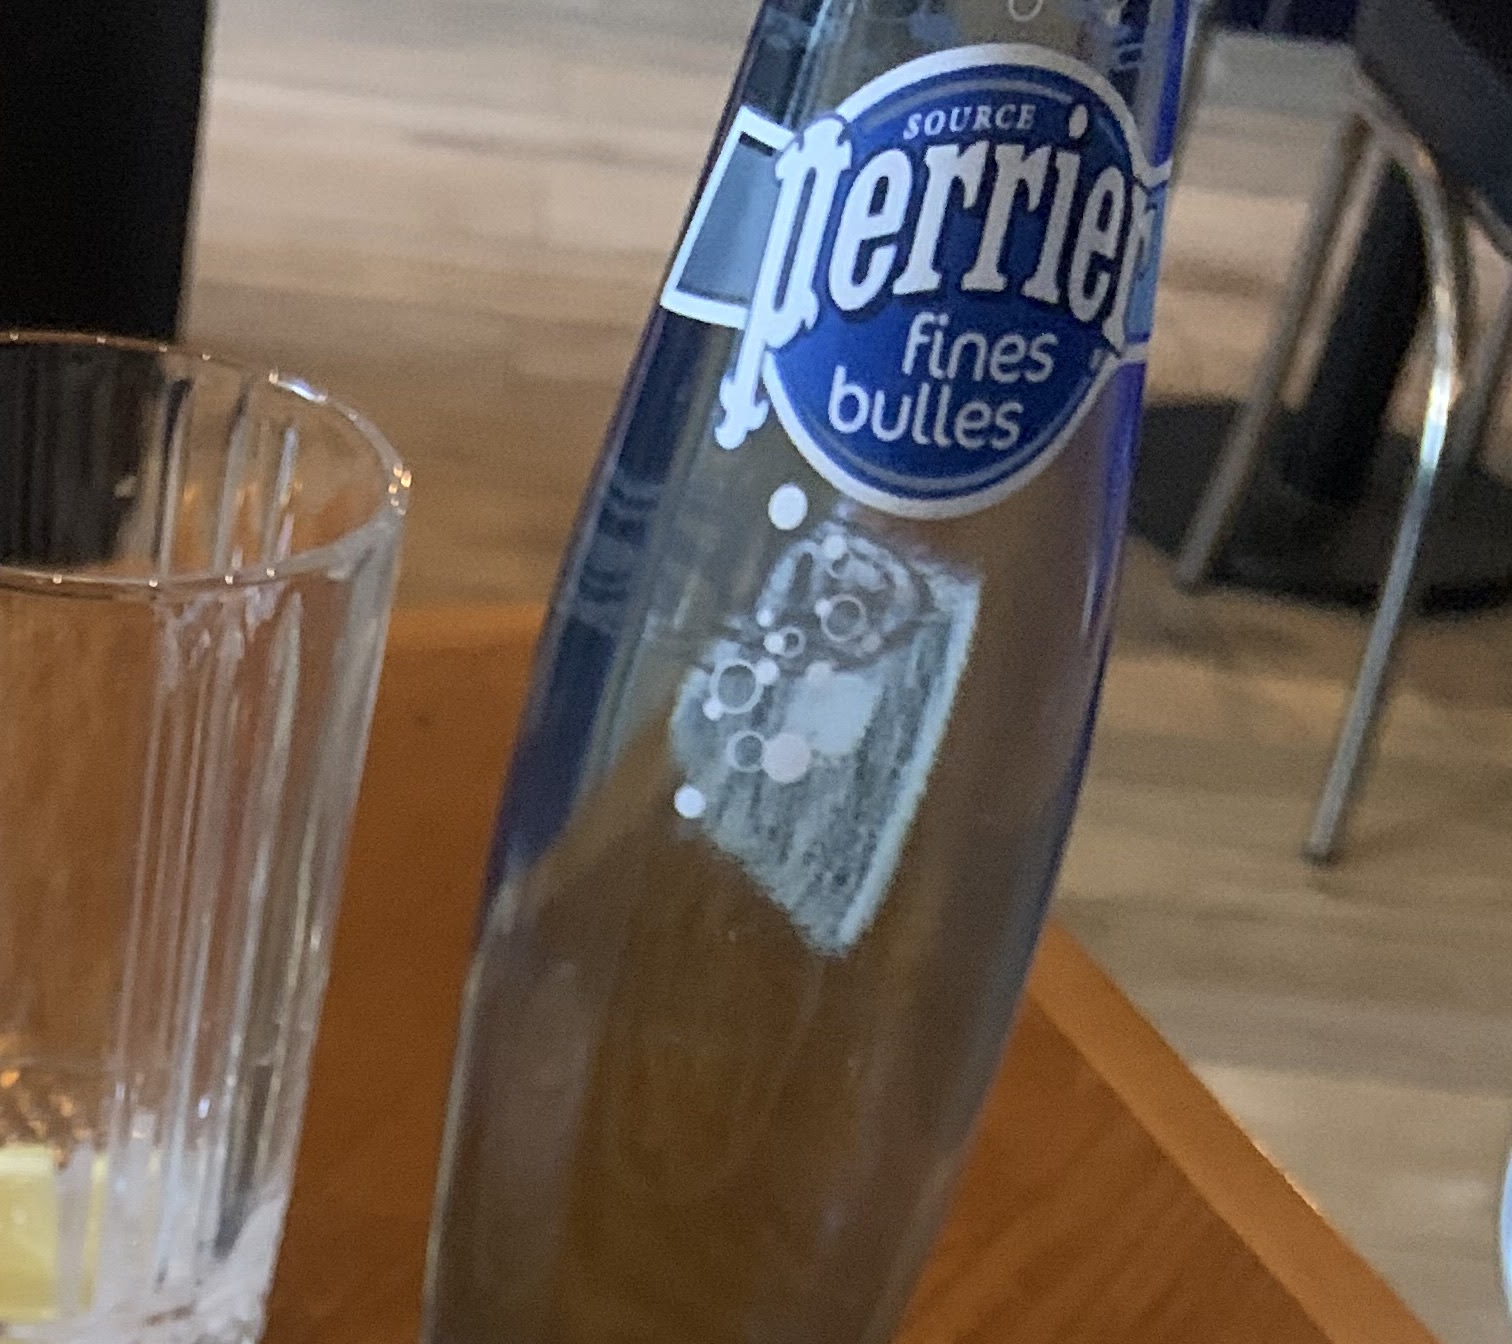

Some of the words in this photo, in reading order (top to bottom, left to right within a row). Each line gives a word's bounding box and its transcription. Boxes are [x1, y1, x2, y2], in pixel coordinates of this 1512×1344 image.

[903, 105, 1036, 140] SOURCE
[902, 311, 1058, 384] fines
[827, 366, 1025, 450] bulles
